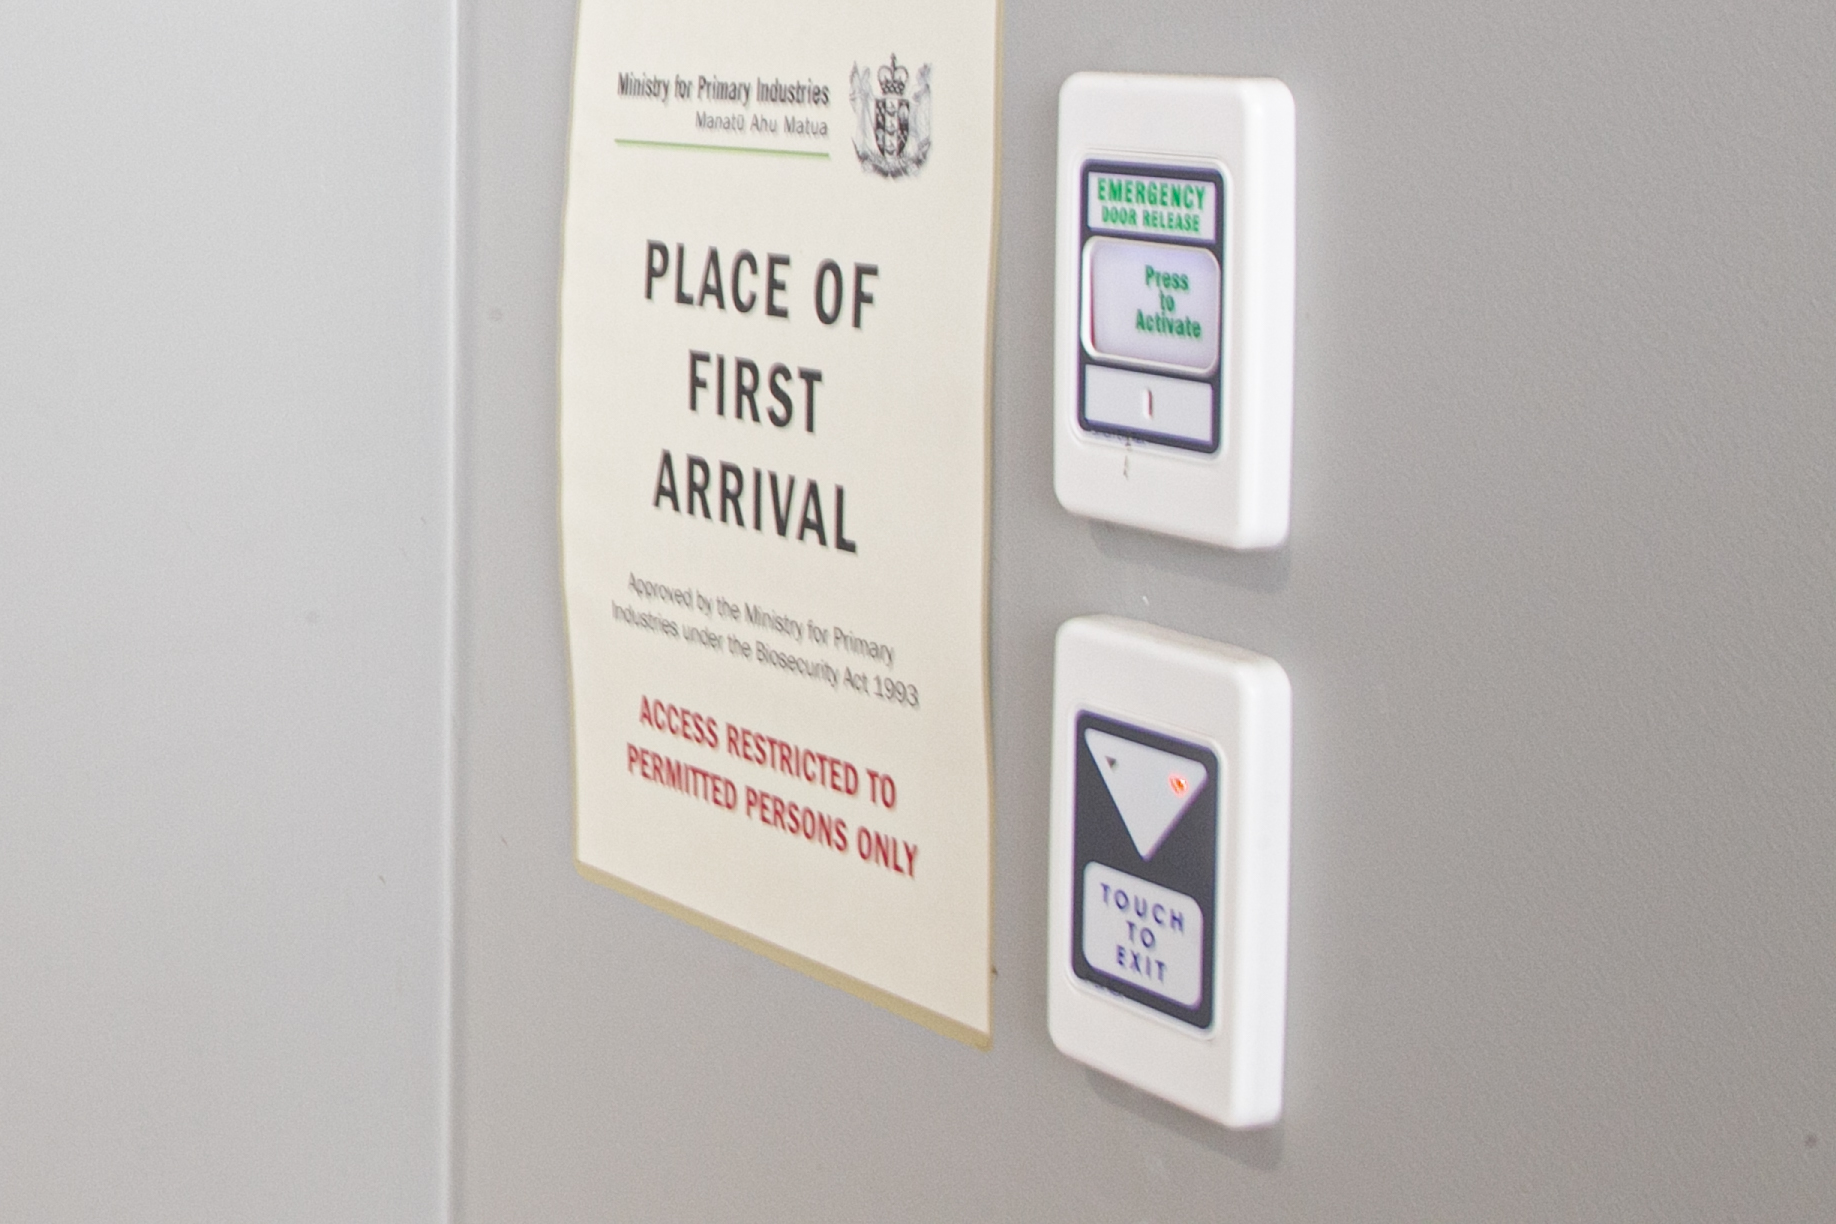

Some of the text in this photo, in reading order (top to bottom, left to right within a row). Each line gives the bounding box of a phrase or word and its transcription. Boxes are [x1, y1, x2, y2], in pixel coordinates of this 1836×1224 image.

[617, 72, 830, 109] Ministry for Primary Industries
[750, 115, 778, 134] Ahu
[783, 116, 828, 137] Matua
[1097, 177, 1206, 210] EMERGENCY
[1102, 206, 1201, 233] DOOR RELEASE
[644, 239, 879, 329] PLACE OF
[1144, 264, 1189, 291] Press
[1159, 290, 1175, 312] to
[1136, 308, 1202, 339] Activate
[688, 348, 823, 434] FIRST
[652, 448, 858, 555] ARRIVAL
[628, 571, 895, 669] Approved by the Ministry for Primary
[611, 599, 920, 708] Industries under the Biosecurity Act 1993
[639, 694, 897, 809] ACCESS RESTRICTED TO
[626, 743, 918, 878] PERMITTED PERSONS ONLY
[1099, 882, 1185, 933] TOUCH
[1126, 920, 1156, 948] TO
[1116, 945, 1167, 982] EXIT
